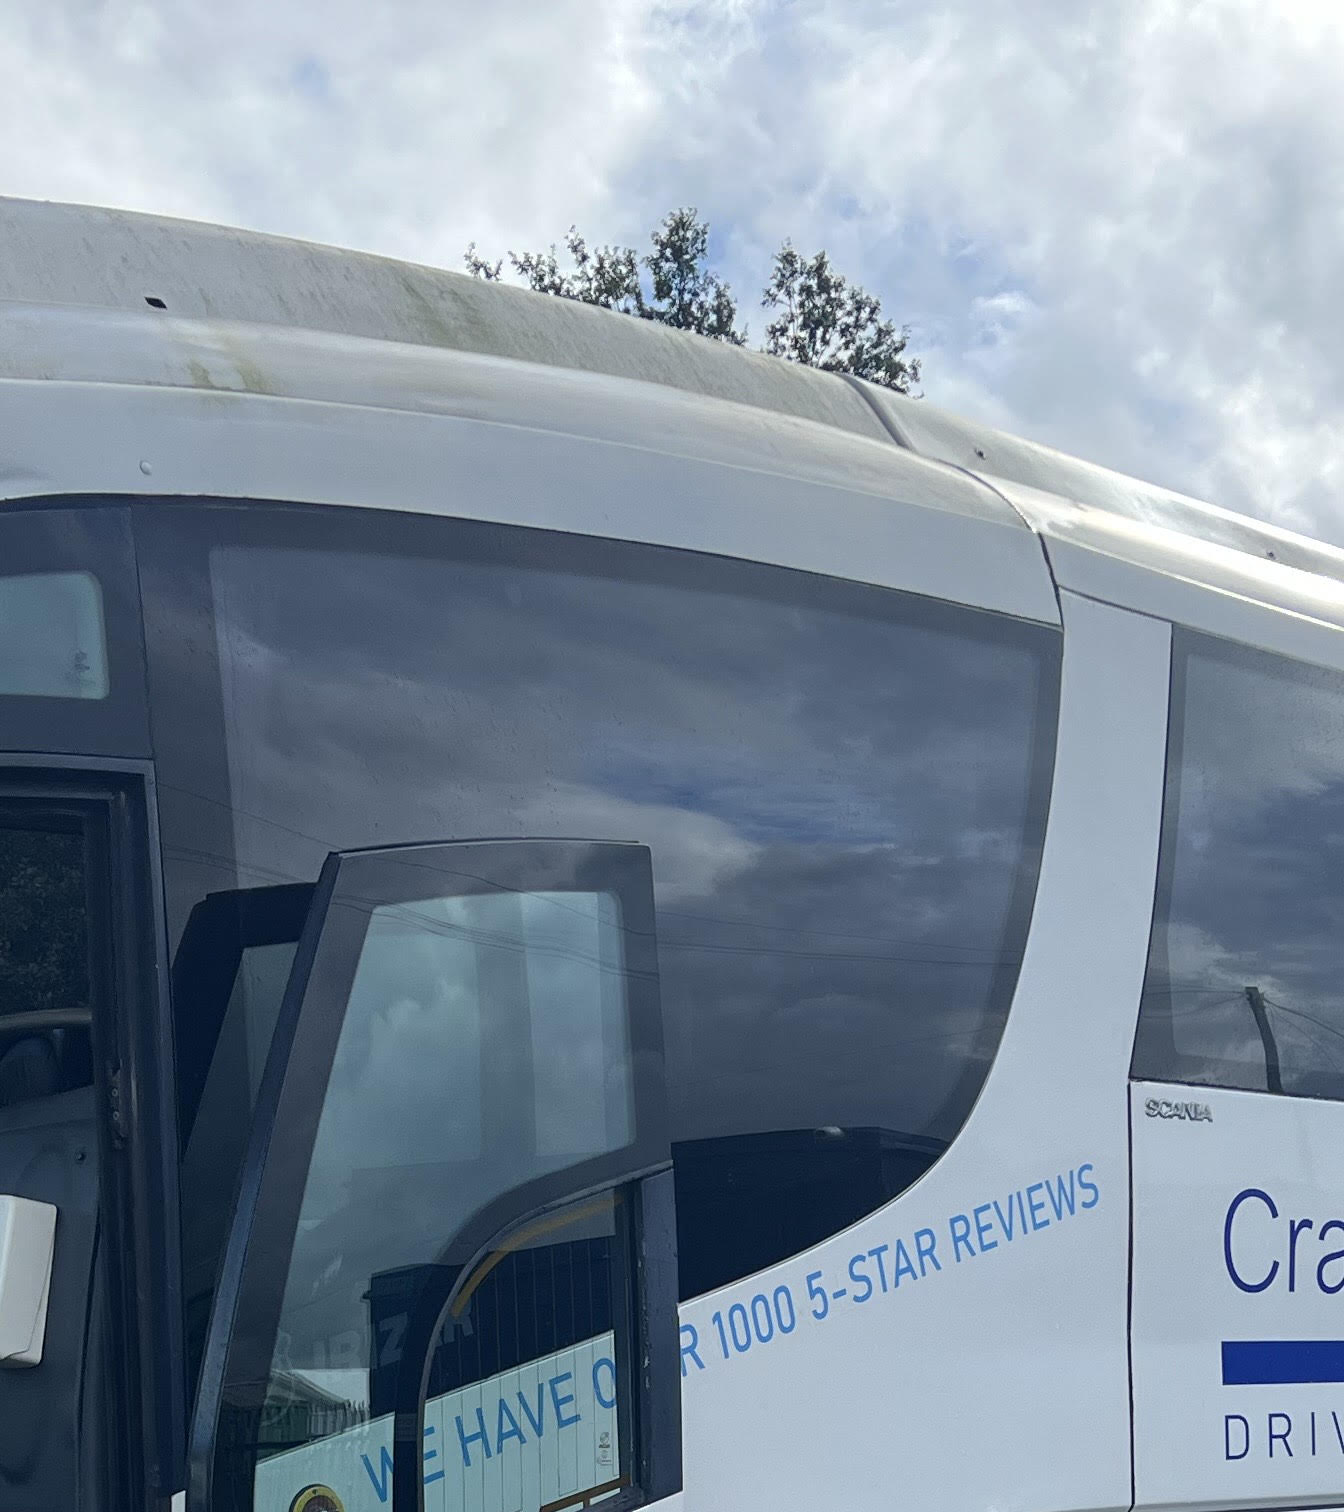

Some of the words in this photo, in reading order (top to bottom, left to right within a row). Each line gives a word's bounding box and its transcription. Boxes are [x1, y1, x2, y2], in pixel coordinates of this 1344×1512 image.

[1144, 1098, 1213, 1122] SCANIA
[360, 1425, 445, 1503] WE
[455, 1372, 581, 1468] HAVE
[711, 1285, 796, 1360] 1000
[805, 1228, 942, 1321] 5-STAR
[948, 1163, 1100, 1264] REVIEWS
